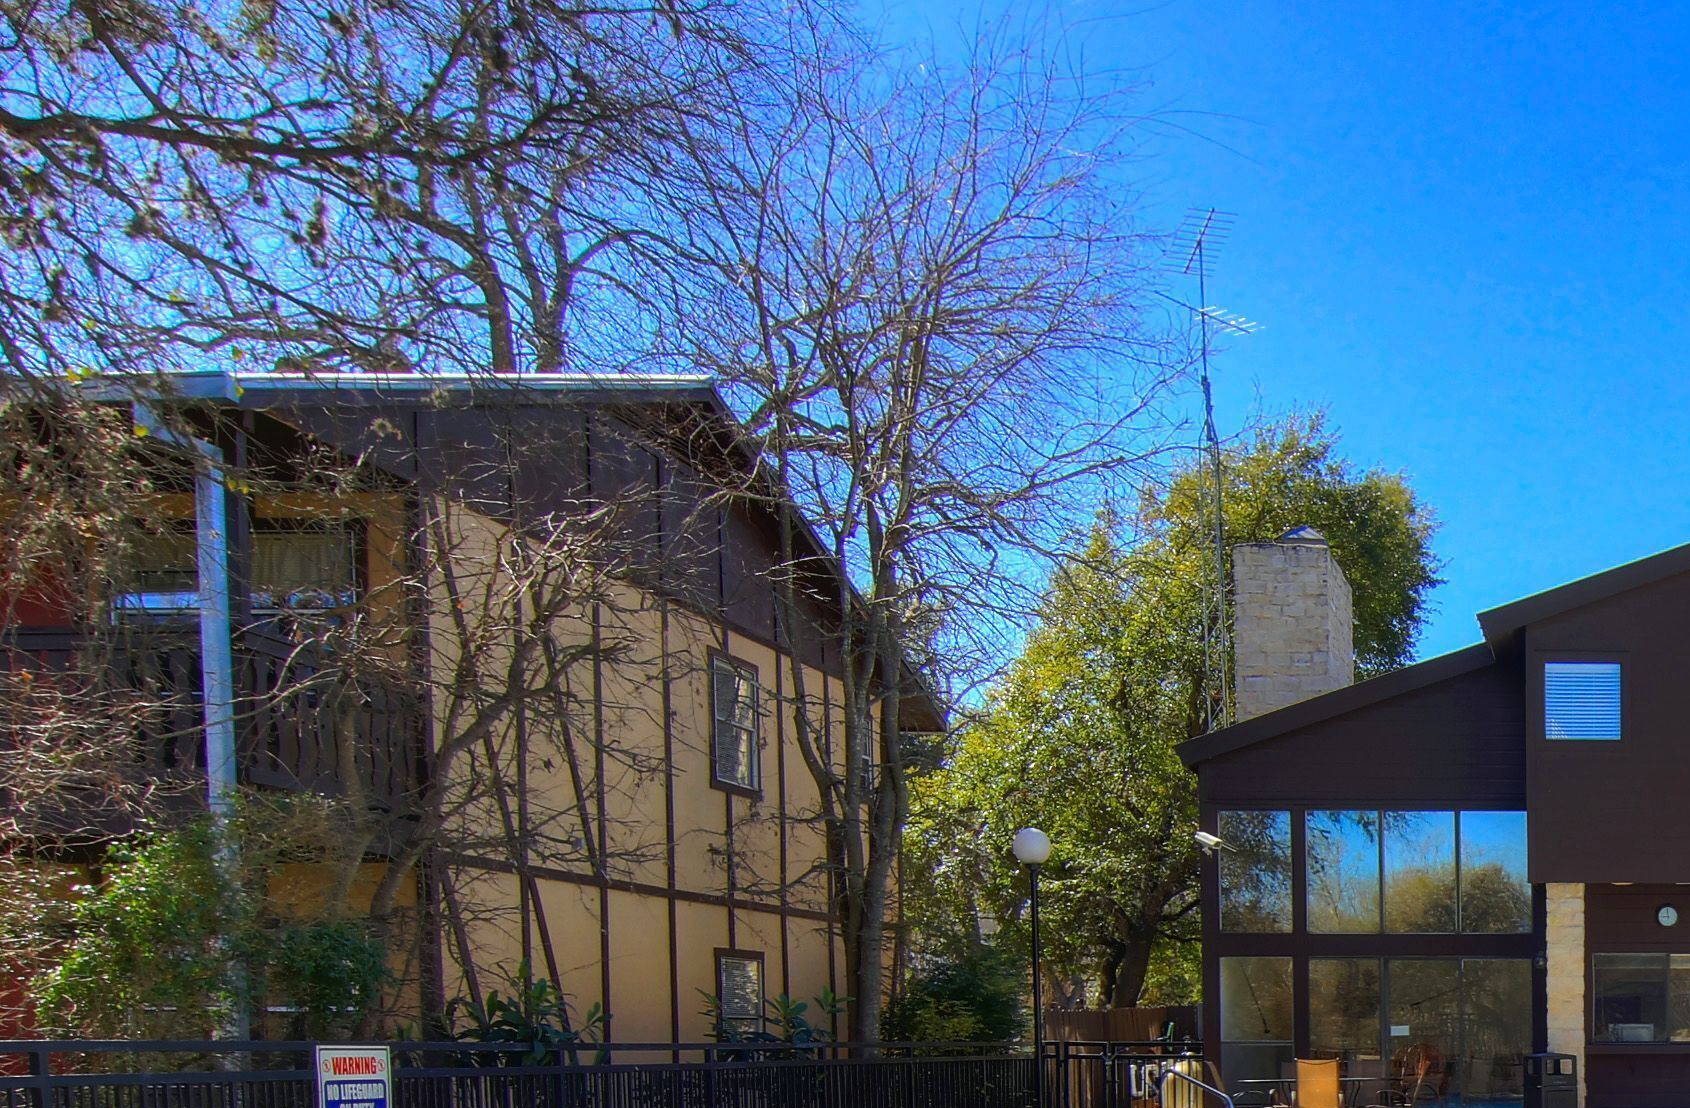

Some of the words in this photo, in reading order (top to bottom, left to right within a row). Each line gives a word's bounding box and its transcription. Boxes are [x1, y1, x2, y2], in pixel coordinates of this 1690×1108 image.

[332, 1057, 376, 1075] WARNING
[327, 1084, 339, 1100] NO
[341, 1083, 384, 1100] LIFEGUARD
